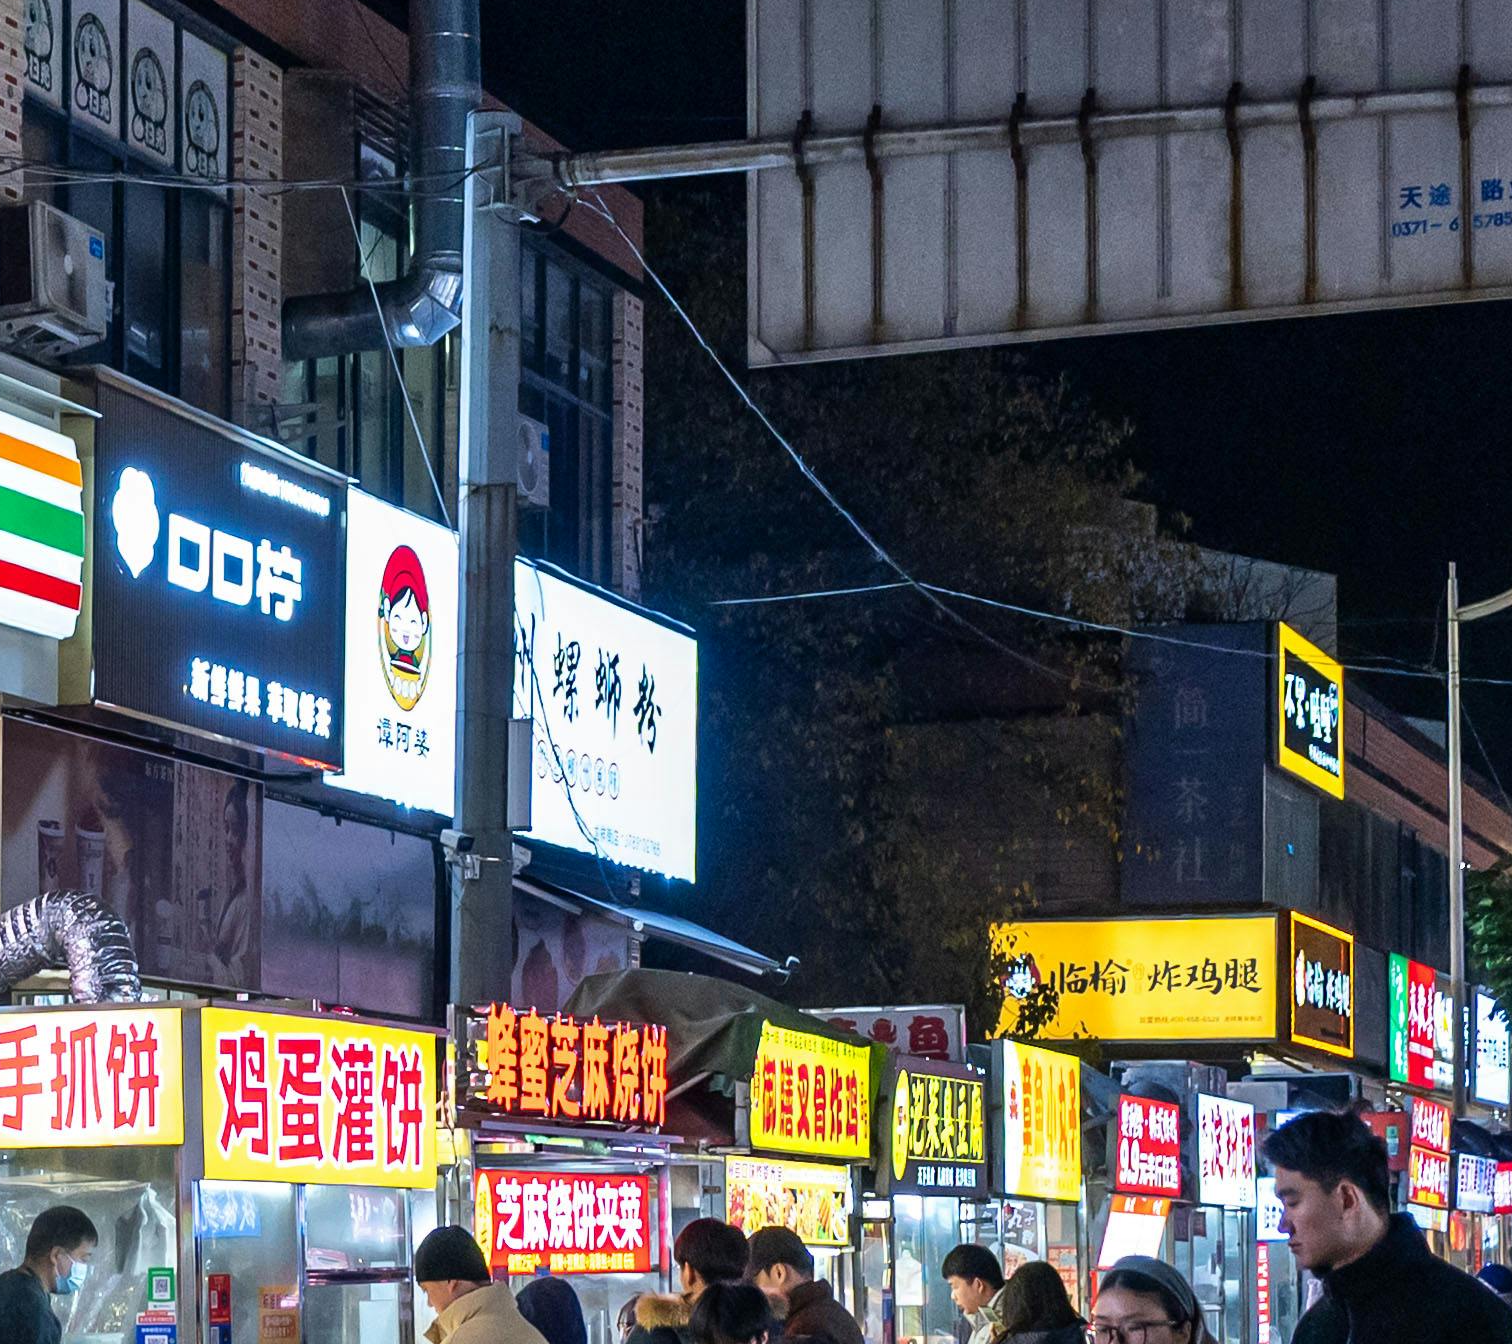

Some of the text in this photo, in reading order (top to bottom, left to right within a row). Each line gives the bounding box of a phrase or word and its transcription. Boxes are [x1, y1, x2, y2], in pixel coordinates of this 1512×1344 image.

[1147, 957, 1263, 995] 炸鸡腿
[218, 1029, 424, 1168] 鸡蛋灌饼
[486, 1000, 669, 1127] 蜂蜜芝麻烧饼
[494, 1175, 644, 1252] 芝麻烧饼夹菜
